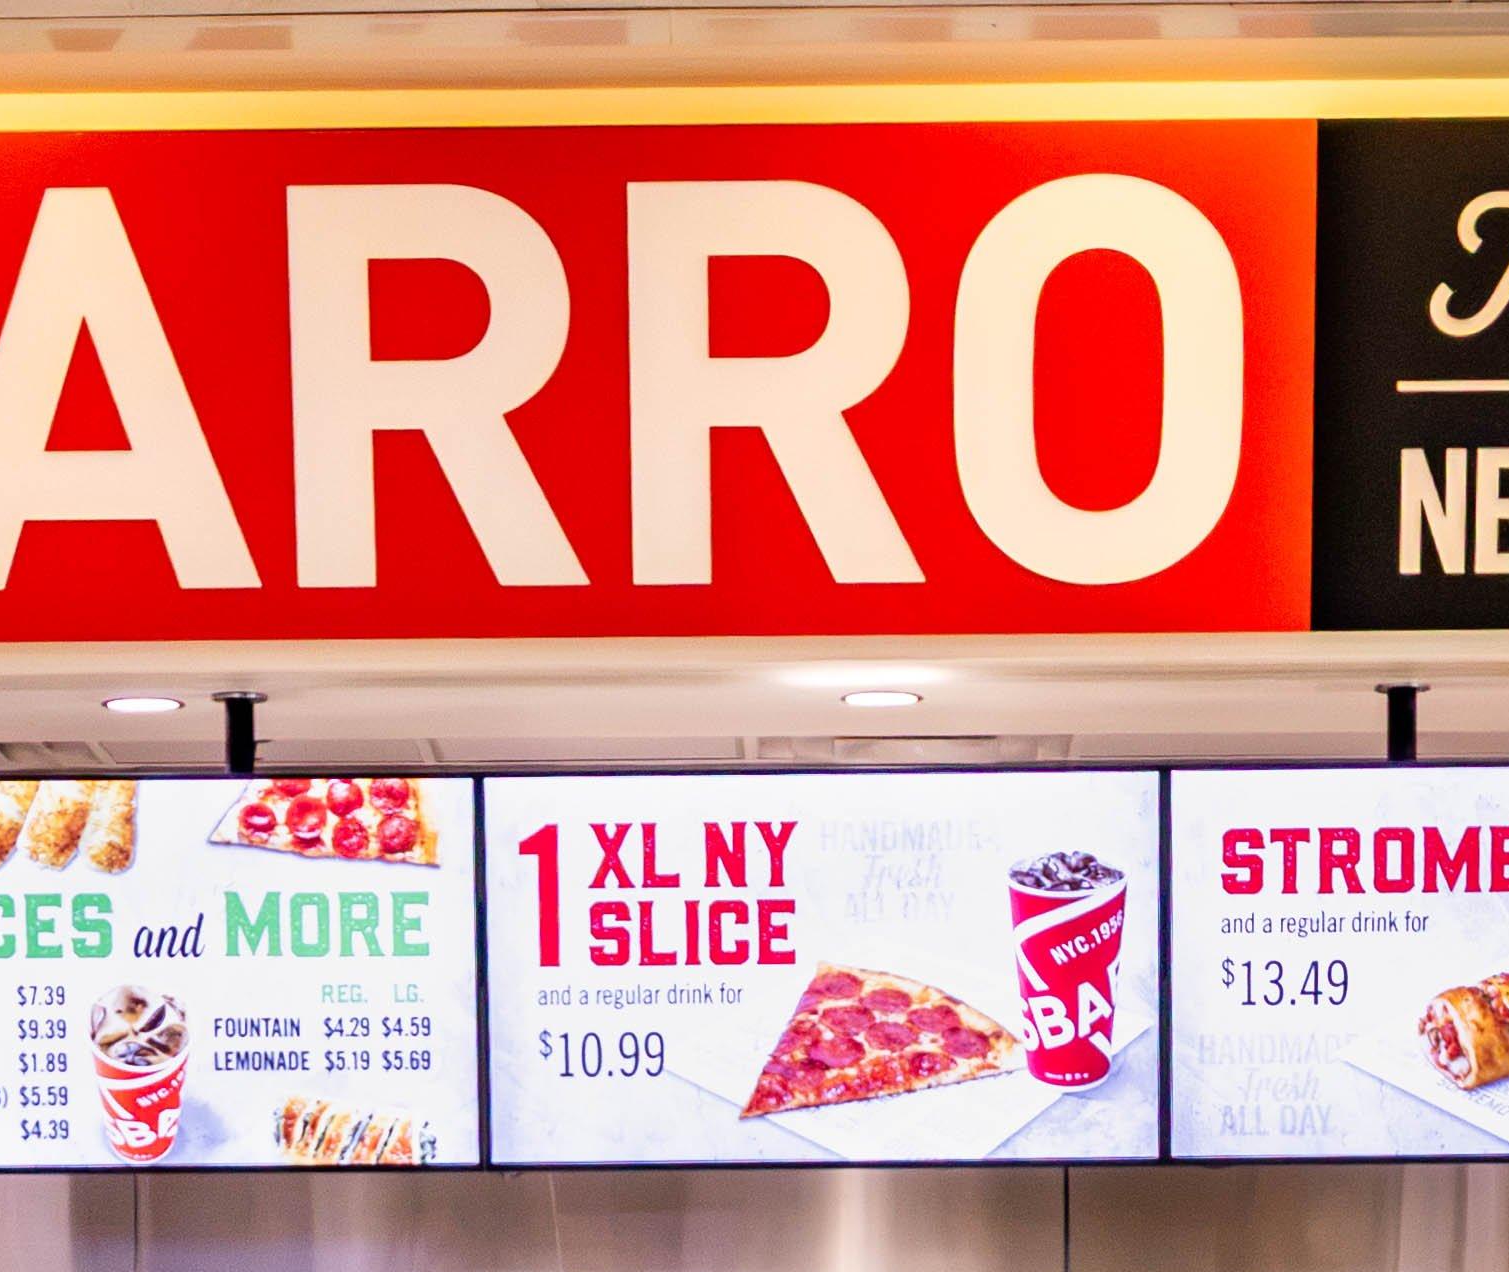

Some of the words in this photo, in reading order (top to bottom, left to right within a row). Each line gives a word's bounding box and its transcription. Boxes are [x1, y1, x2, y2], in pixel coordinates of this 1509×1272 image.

[587, 822, 681, 888] XL
[703, 820, 799, 888] NY
[518, 822, 561, 968] 1
[133, 913, 205, 958] and
[225, 890, 431, 957] MORE
[588, 899, 796, 967] SLICE
[1220, 912, 1255, 934] and
[1261, 917, 1274, 934] a
[1278, 911, 1345, 939] regular
[1351, 910, 1399, 933] drink
[1403, 909, 1430, 933] for
[321, 984, 368, 1003] REG.
[393, 983, 425, 1003] LG.
[1220, 958, 1349, 1007] $13.49
[17, 985, 66, 1007] $7.39
[537, 983, 571, 1006] and
[577, 987, 590, 1006] a
[595, 983, 660, 1011] regular
[666, 983, 714, 1005] drink
[718, 982, 743, 1005] for
[18, 1019, 67, 1041] $9.39
[213, 1017, 301, 1038] FOUNTAIN
[323, 1016, 371, 1038] $4.29
[381, 1016, 431, 1038] $4.59
[18, 1052, 68, 1074] $1.89
[213, 1051, 310, 1071] LEMONADE
[324, 1050, 371, 1072] $5.19
[381, 1050, 431, 1072] $5.69
[538, 1029, 666, 1079] $10.99
[19, 1086, 69, 1108] $5.59
[20, 1119, 70, 1141] $4.39
